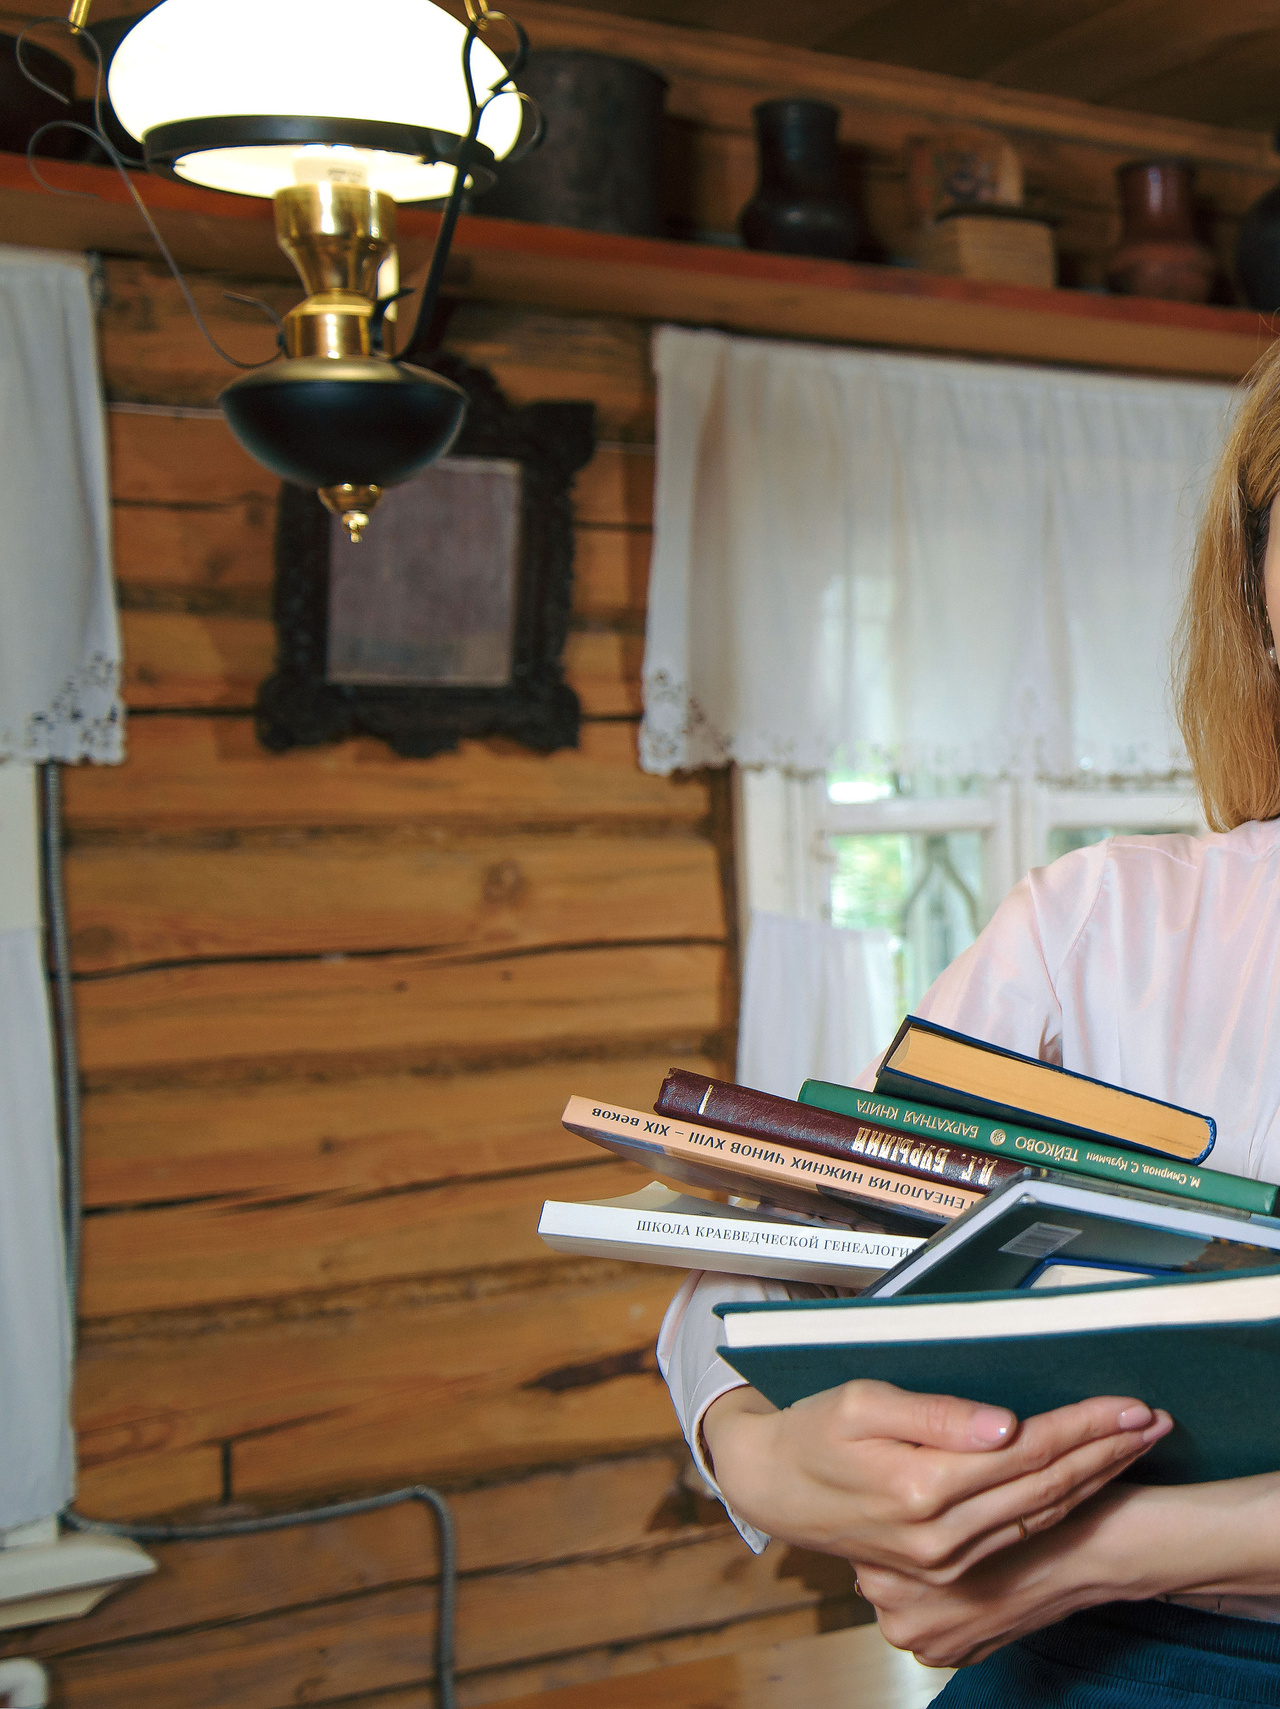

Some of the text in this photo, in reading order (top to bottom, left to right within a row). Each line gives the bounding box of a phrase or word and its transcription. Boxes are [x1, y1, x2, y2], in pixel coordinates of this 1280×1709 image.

[592, 1107, 639, 1126] веков
[856, 1099, 900, 1120] КНИГА
[643, 1120, 670, 1136] XIX
[903, 1110, 980, 1139] БАРХАТНАЯ
[688, 1131, 726, 1150] XVIII
[850, 1126, 951, 1174] БУРЫЛИН
[1015, 1136, 1079, 1162] ТЕЙКОВО
[730, 1142, 785, 1165] ЧИНОВ
[1086, 1152, 1129, 1171] Кузьмин
[790, 1156, 864, 1184] НИЖНИХ
[636, 1220, 915, 1258] ШКОЛА КРАЕВЕДЧЕСКОЙ ГЕНЕАЛОГИ
